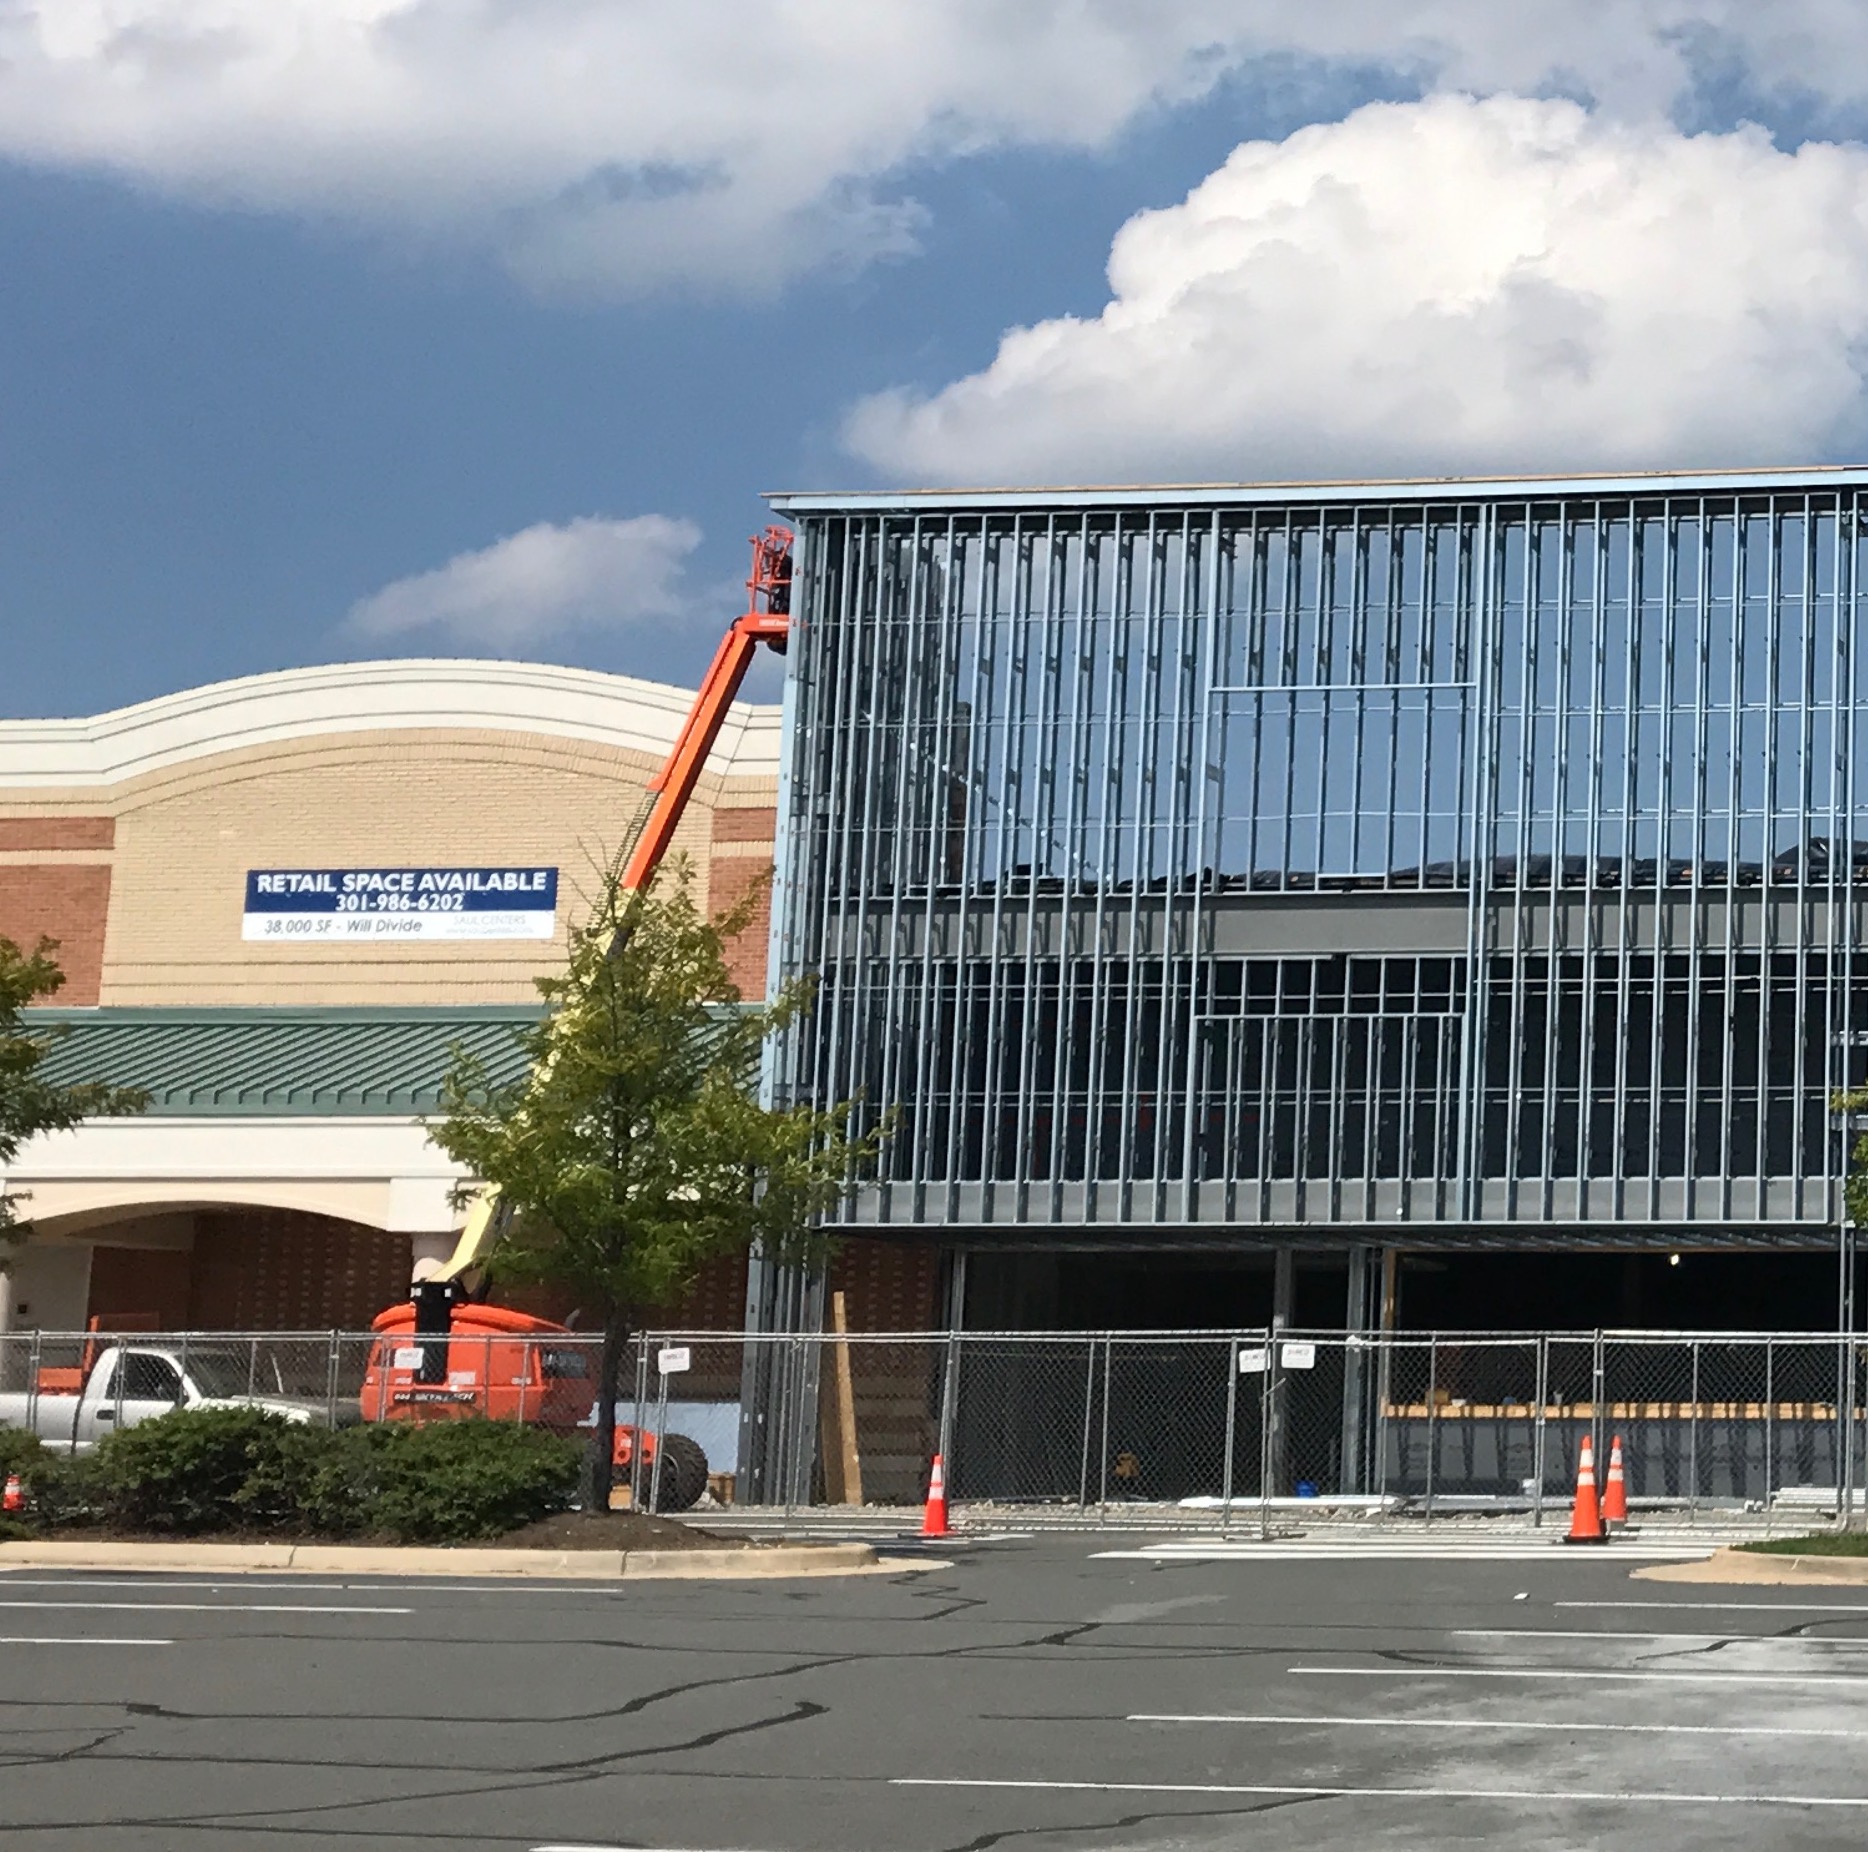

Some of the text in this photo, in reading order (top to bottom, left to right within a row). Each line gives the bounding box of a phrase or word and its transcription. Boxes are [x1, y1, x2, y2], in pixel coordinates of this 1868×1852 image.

[257, 871, 547, 893] RETAIL SPACE AVAILABLE
[335, 893, 463, 911] 301-986-6202
[315, 919, 333, 933] SF
[347, 918, 373, 932] Will
[375, 918, 423, 933] Divide
